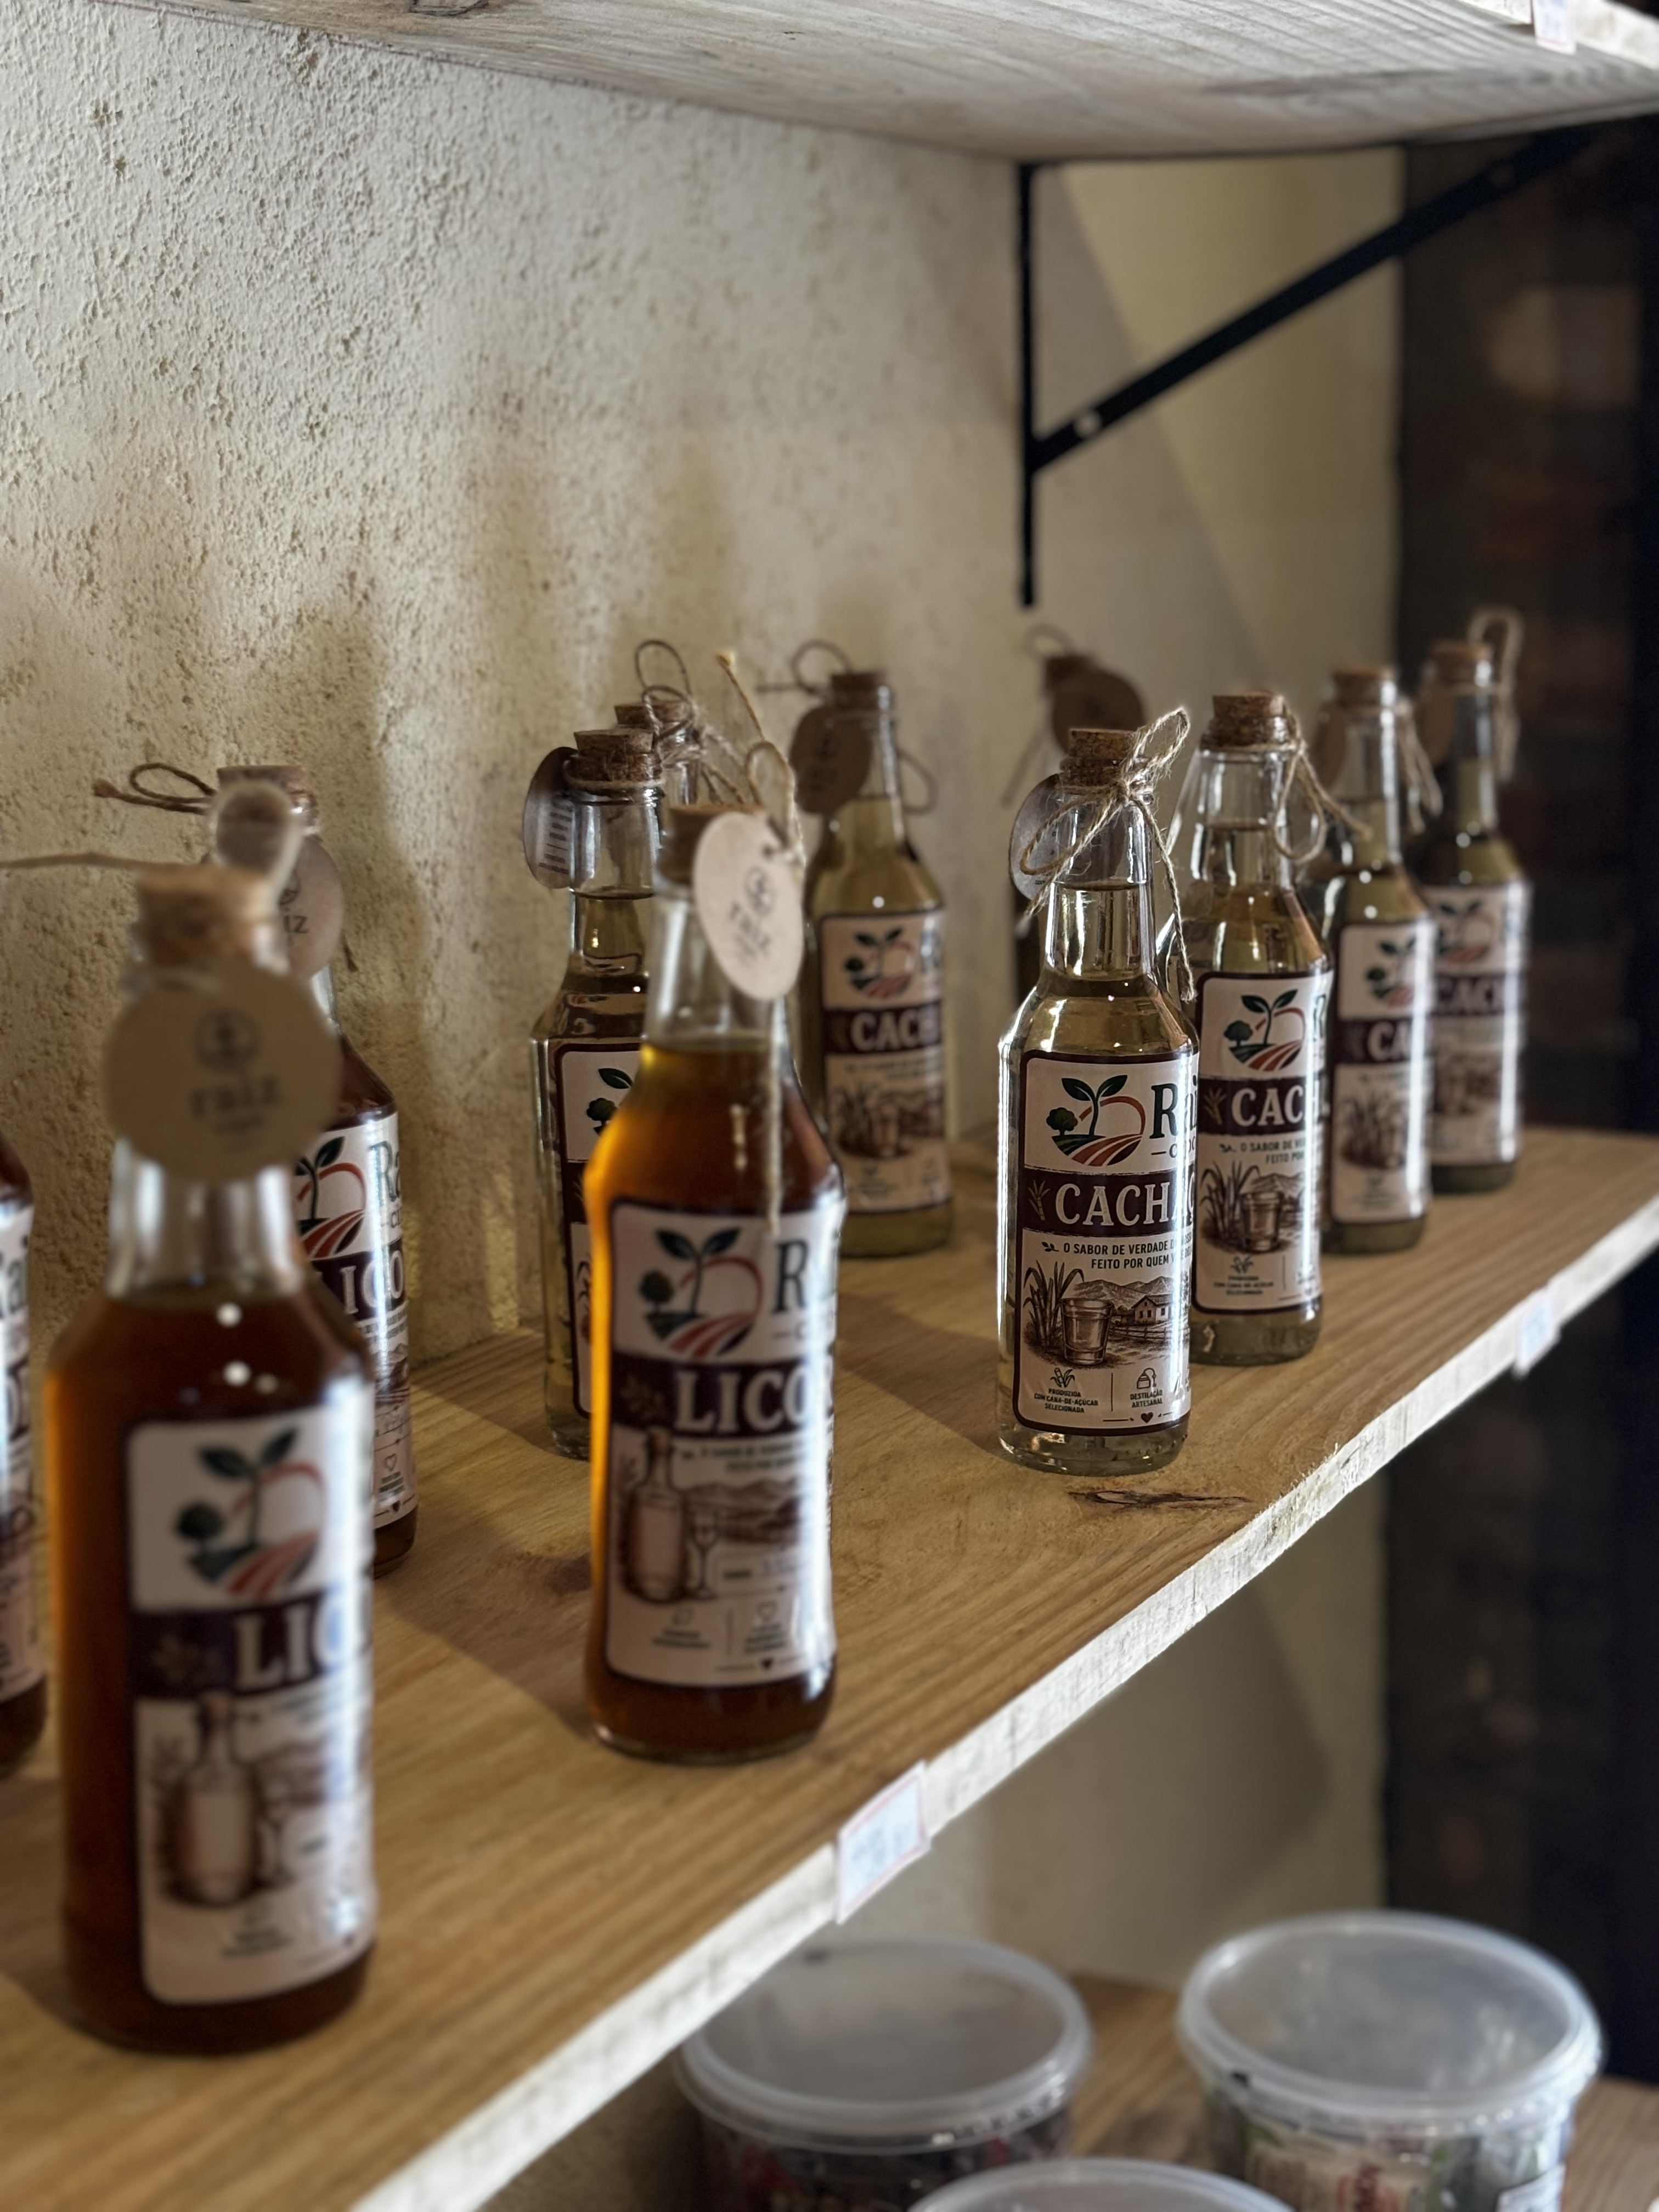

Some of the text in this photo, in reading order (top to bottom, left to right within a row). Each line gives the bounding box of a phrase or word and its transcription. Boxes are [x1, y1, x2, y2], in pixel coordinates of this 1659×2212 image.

[1232, 1085, 1305, 1126] CAC
[1063, 1243, 1070, 1253] O
[1074, 1244, 1108, 1255] SABOR
[1112, 1244, 1125, 1255] DE
[1128, 1240, 1168, 1254] VERDADE
[1091, 1259, 1120, 1269] FEITO
[1124, 1258, 1143, 1269] POR
[1146, 1254, 1169, 1268] QUEM
[1034, 1393, 1046, 1401] COM
[1048, 1388, 1081, 1398] PRODUZIDA
[1130, 1389, 1163, 1401] DESTILAÇÃO
[1044, 1402, 1085, 1413] SELECIONADA
[1131, 1397, 1163, 1409] ARTESANAL
